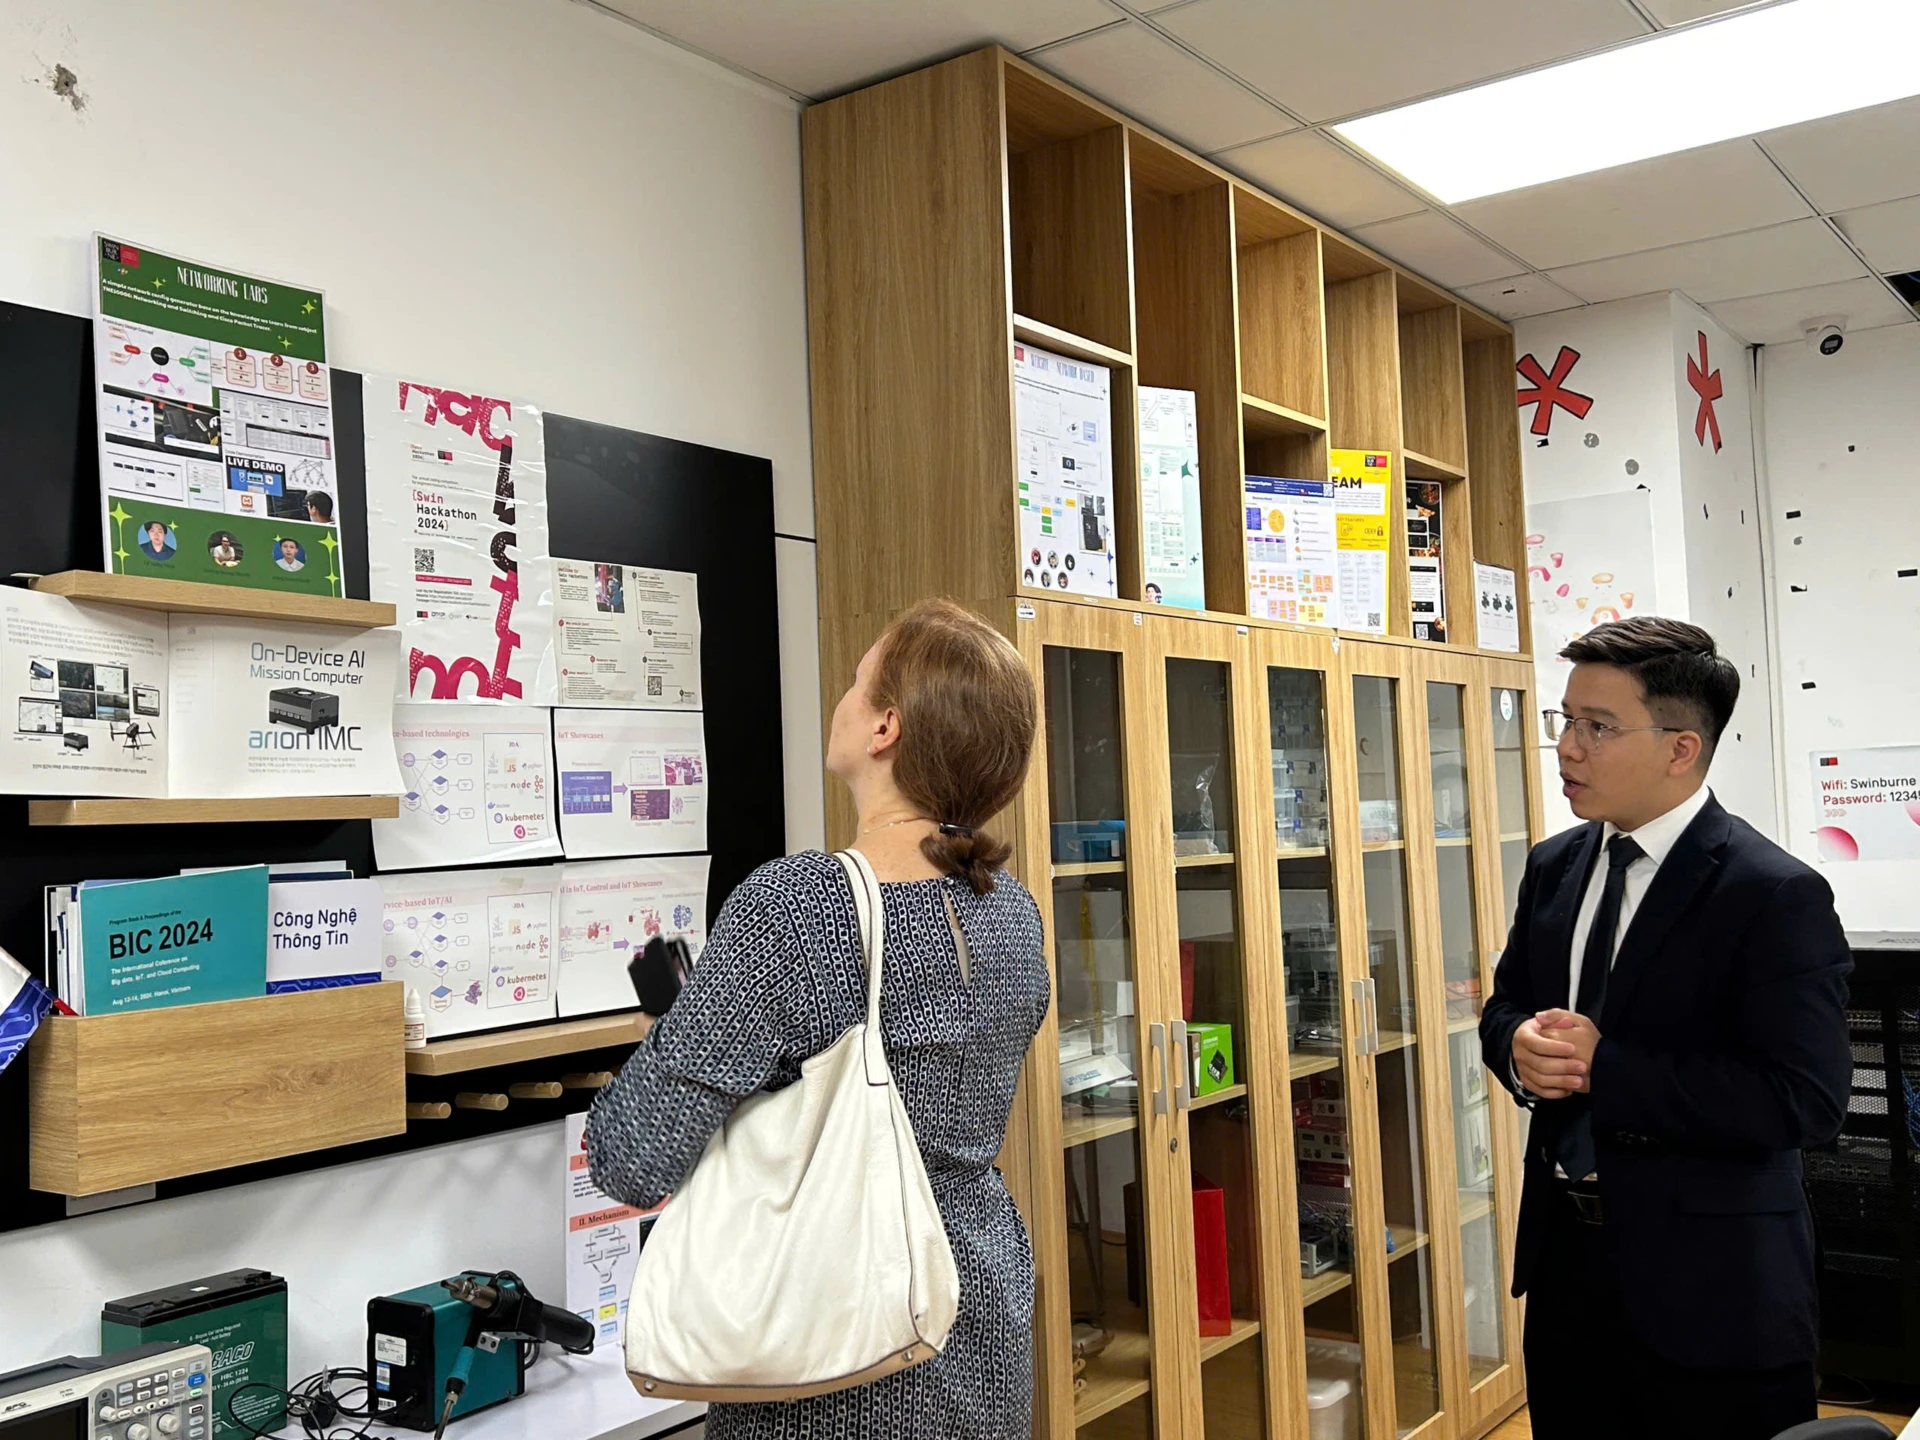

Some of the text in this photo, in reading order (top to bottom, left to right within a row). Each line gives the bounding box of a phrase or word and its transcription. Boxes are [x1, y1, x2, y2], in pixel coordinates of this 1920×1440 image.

[127, 286, 151, 296] network
[177, 266, 268, 304] NETWORKING LABS
[133, 294, 167, 309] Networking
[228, 457, 283, 472] LIVE DEMO
[1332, 476, 1362, 489] EAM
[416, 503, 477, 520] Hackathon
[251, 642, 365, 668] On-Device AI
[250, 664, 364, 686] Mission Computer
[248, 726, 363, 751] arion IMC
[425, 729, 470, 739] technologies
[511, 779, 531, 789] node
[1821, 777, 1917, 791] Wifi: Swinburne
[1823, 793, 1887, 805] Password:
[505, 813, 545, 821] kubernetes
[586, 883, 609, 892] Control
[609, 882, 620, 890] and
[621, 881, 631, 889] IoT
[632, 880, 663, 888] Showcases
[274, 907, 357, 929] Công Nghệ
[512, 926, 521, 934] JS
[109, 917, 214, 960] BIC 2024
[273, 929, 348, 950] Thông Tin
[516, 940, 536, 950] node
[122, 961, 154, 973] International
[111, 978, 120, 986] Big
[157, 968, 172, 977] Cloud
[173, 964, 200, 974] Computing
[507, 973, 547, 984] kubernetes
[112, 998, 123, 1006] Aug
[588, 1209, 629, 1224] Mechanism
[220, 1367, 249, 1381] HBC 1224
